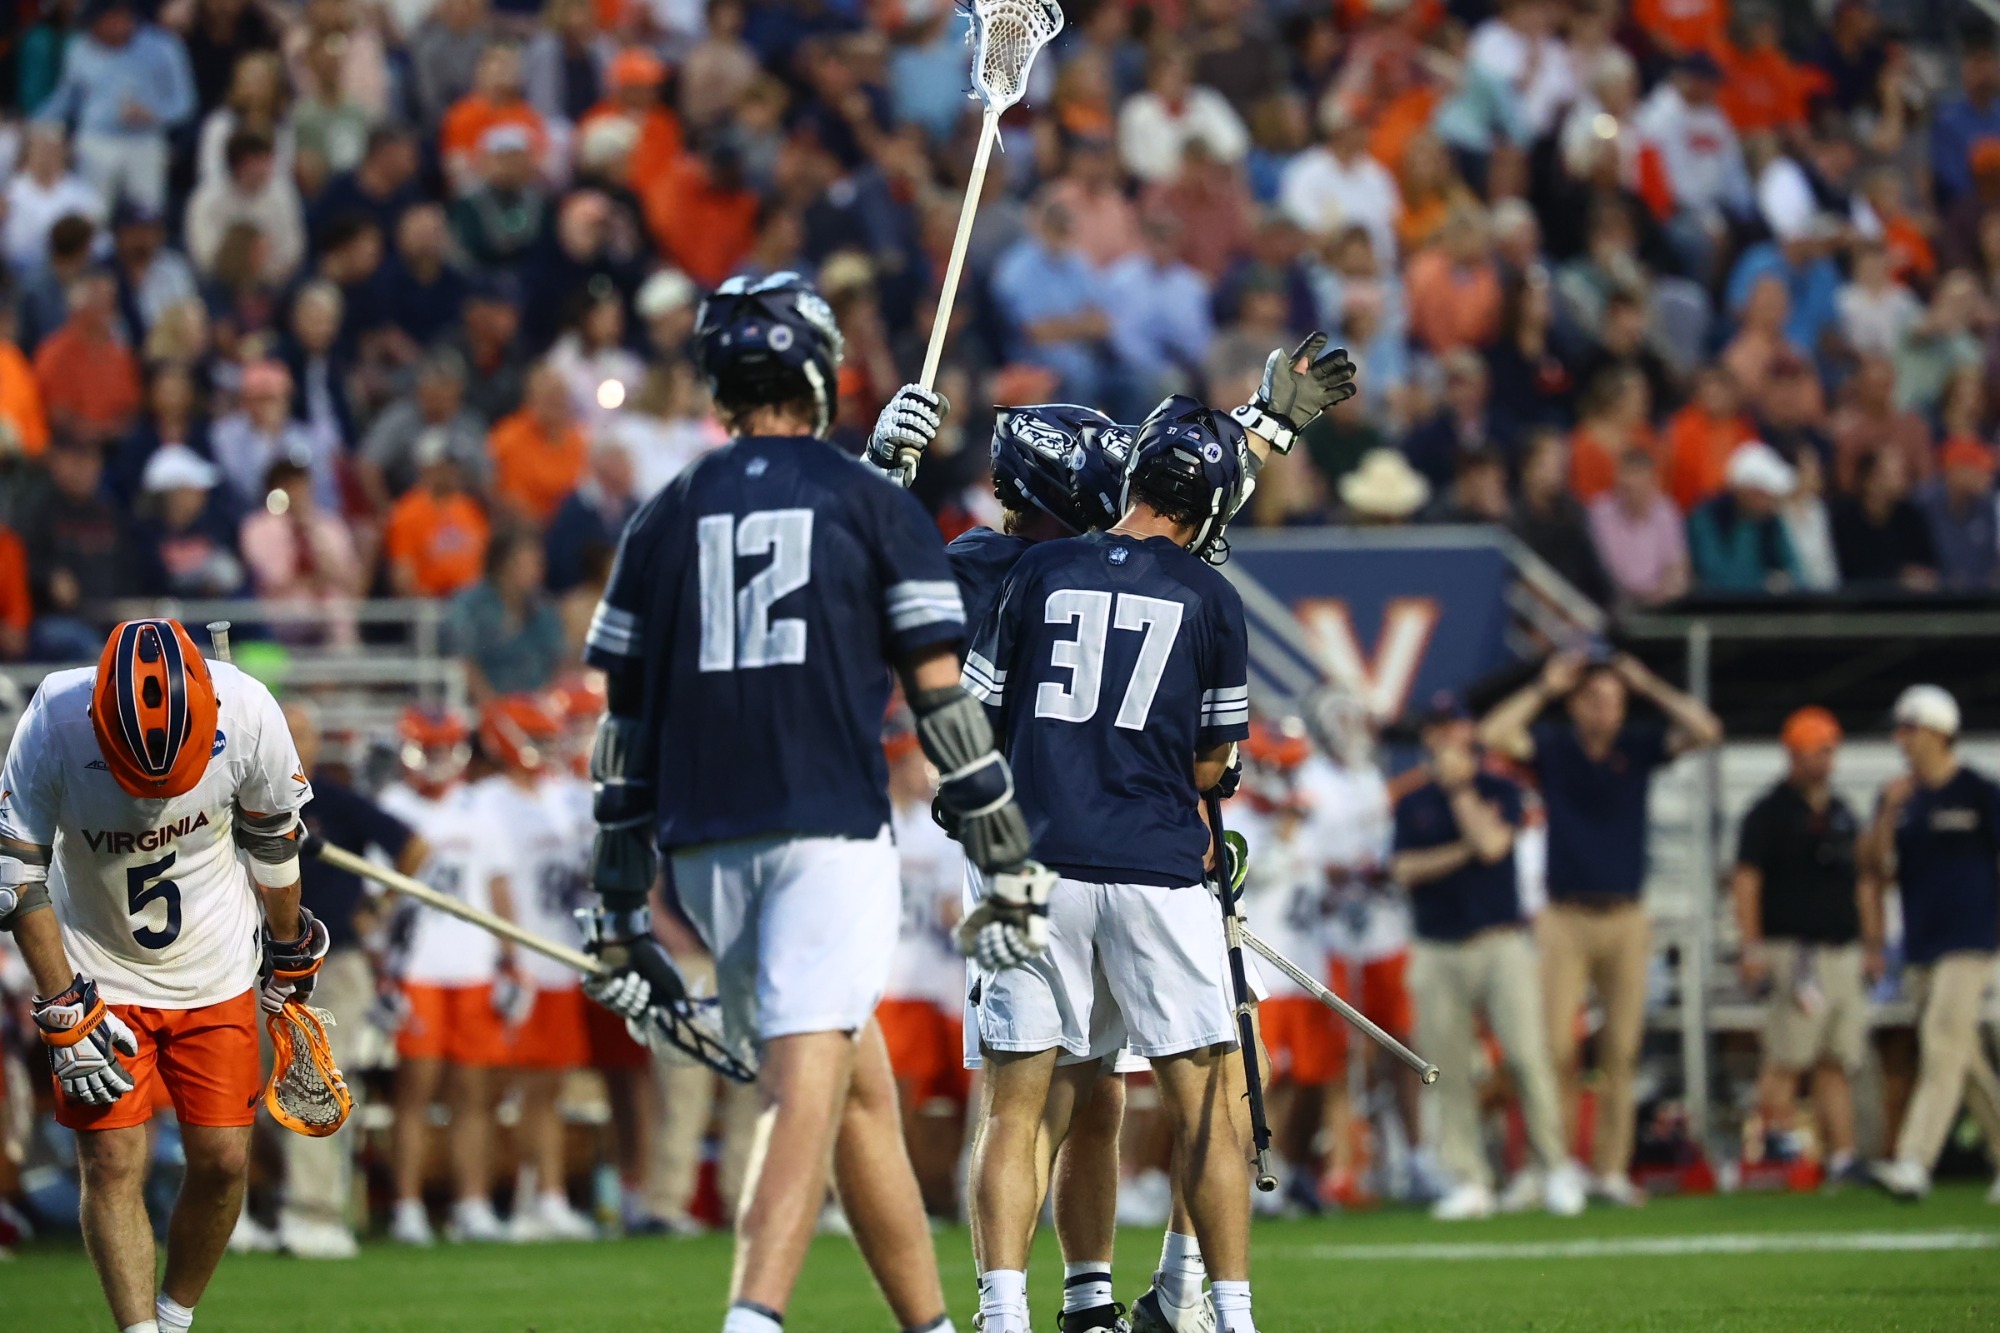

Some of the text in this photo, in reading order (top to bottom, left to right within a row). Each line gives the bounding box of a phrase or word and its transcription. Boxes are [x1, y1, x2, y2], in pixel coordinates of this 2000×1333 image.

[1166, 426, 1178, 435] 37
[697, 508, 815, 672] 12
[1034, 588, 1185, 732] 37
[81, 810, 210, 855] VIRGINIA
[126, 850, 183, 950] 5
